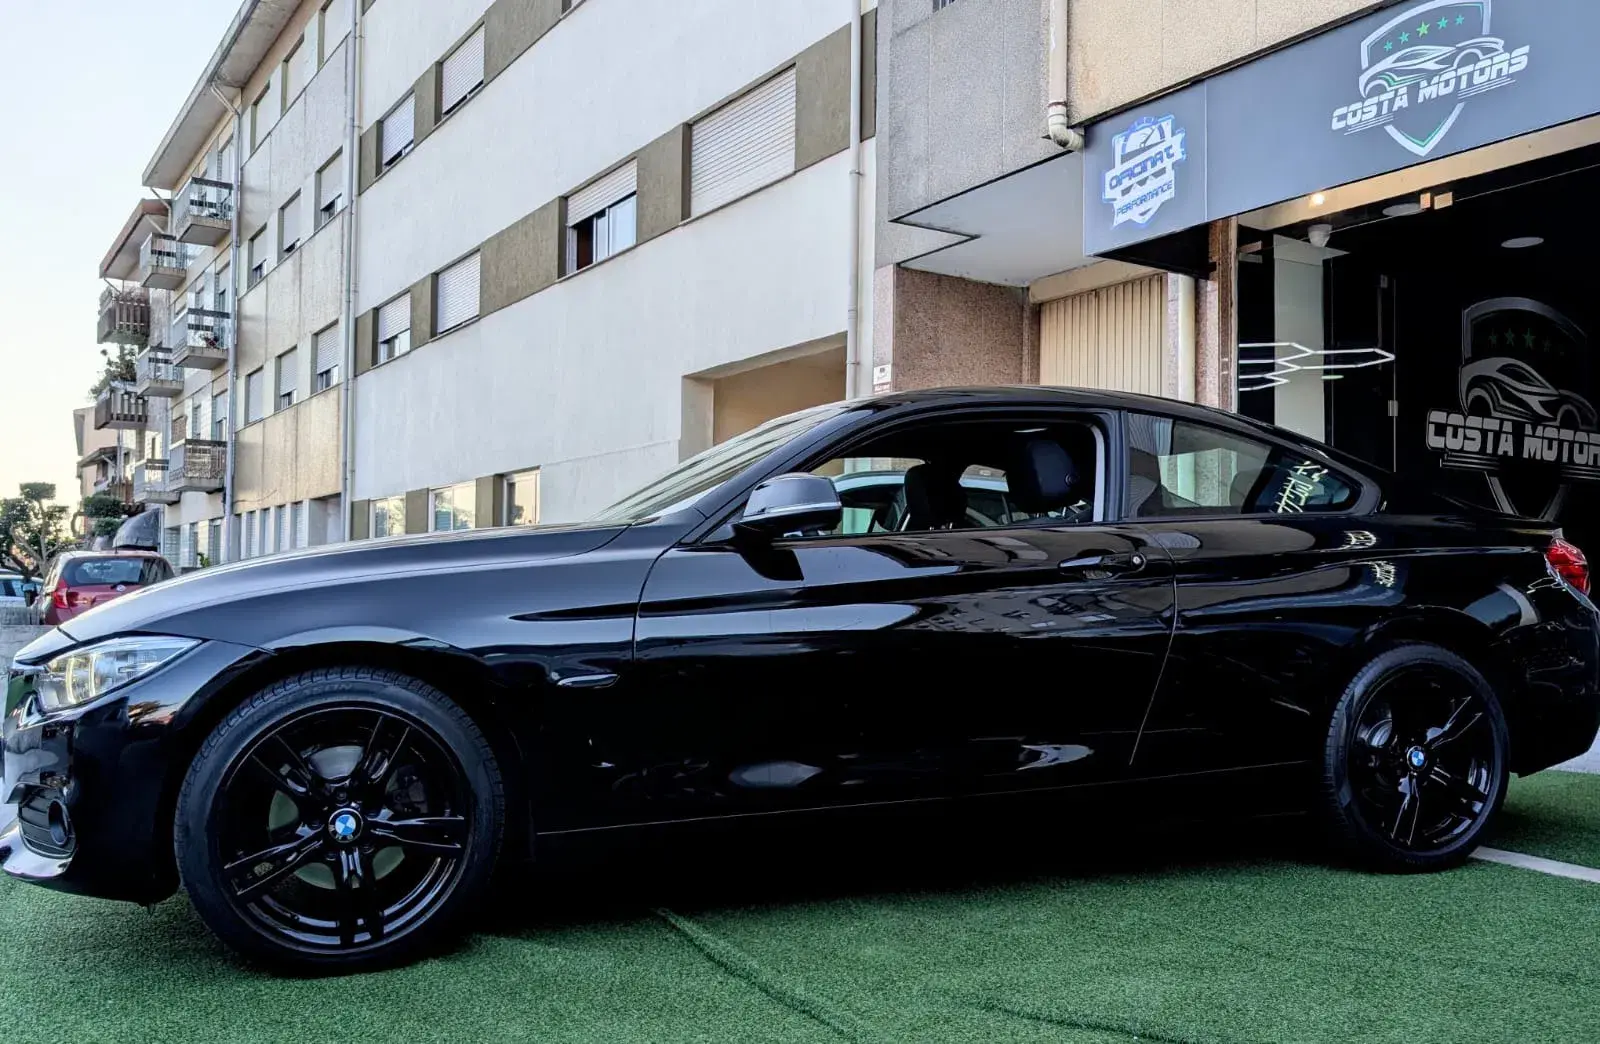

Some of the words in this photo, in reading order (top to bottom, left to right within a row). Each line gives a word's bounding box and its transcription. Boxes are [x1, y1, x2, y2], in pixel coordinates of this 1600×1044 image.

[1331, 87, 1409, 130] COSTA
[1417, 45, 1530, 103] MOTORS
[1116, 180, 1173, 216] PERFORMANCE
[1427, 410, 1514, 457] COSTA
